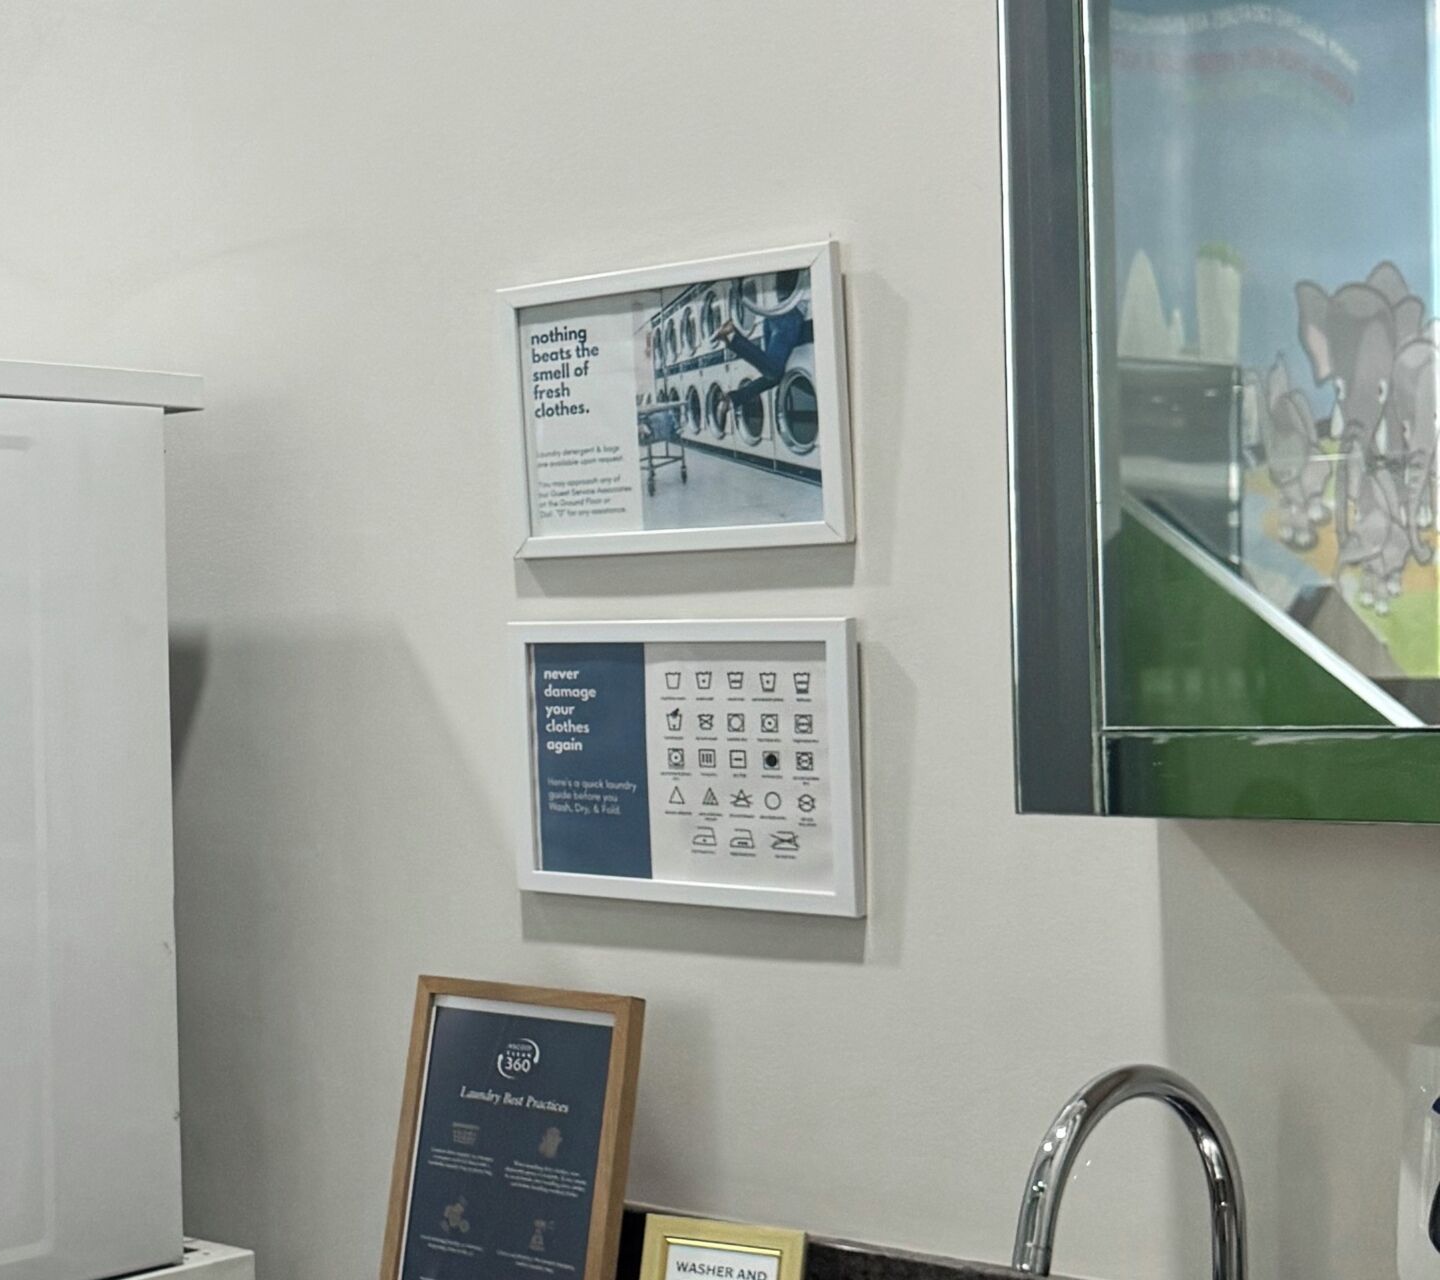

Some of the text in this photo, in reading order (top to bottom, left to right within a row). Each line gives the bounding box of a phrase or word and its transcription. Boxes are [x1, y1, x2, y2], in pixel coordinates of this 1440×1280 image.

[531, 326, 587, 344] nothing
[532, 343, 599, 363] beats the
[533, 360, 589, 382] smell of
[534, 381, 570, 400] fresh
[534, 400, 590, 418] clothes.
[543, 669, 580, 680] never
[544, 683, 597, 702] damage
[545, 705, 576, 719] your
[545, 719, 590, 734] clothes
[547, 737, 583, 755] again
[504, 1056, 532, 1073] 360
[460, 1085, 569, 1113] Laundry Best Practices
[676, 1261, 733, 1278] WASHER
